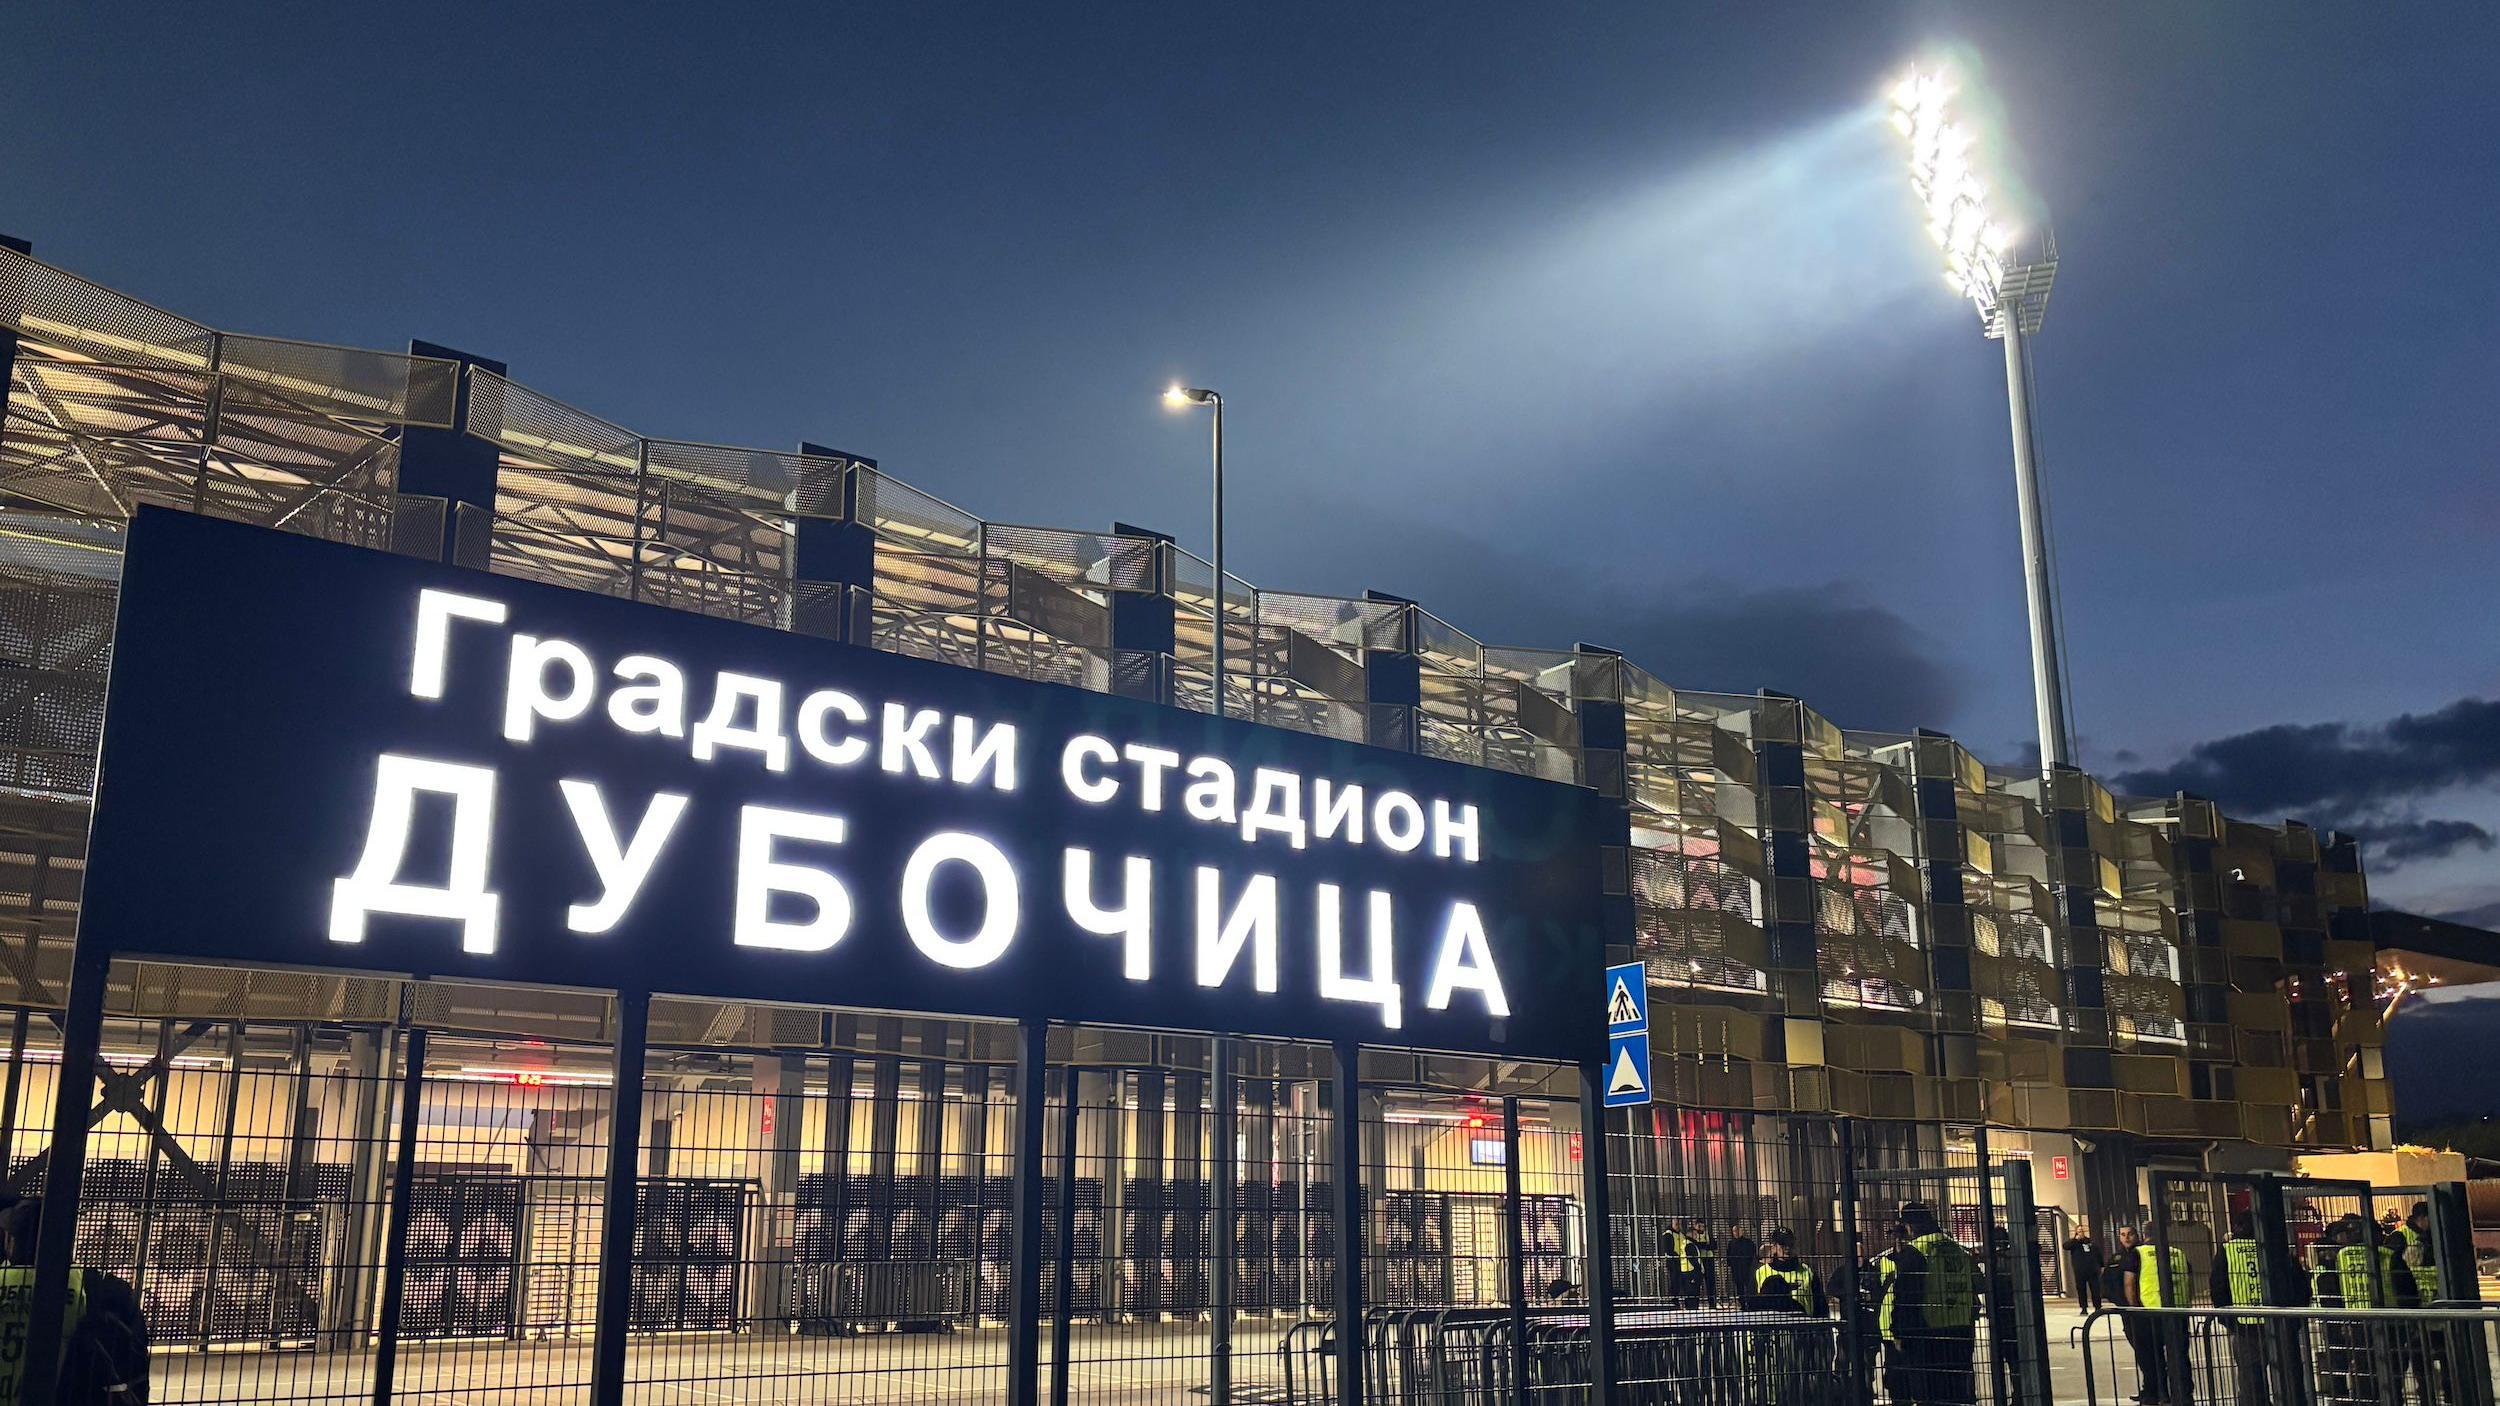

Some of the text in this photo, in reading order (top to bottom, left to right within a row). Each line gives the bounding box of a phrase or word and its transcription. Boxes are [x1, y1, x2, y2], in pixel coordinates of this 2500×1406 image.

[411, 589, 1479, 862] Градски стадион
[329, 755, 1511, 1029] ДУБОЧИЦА
